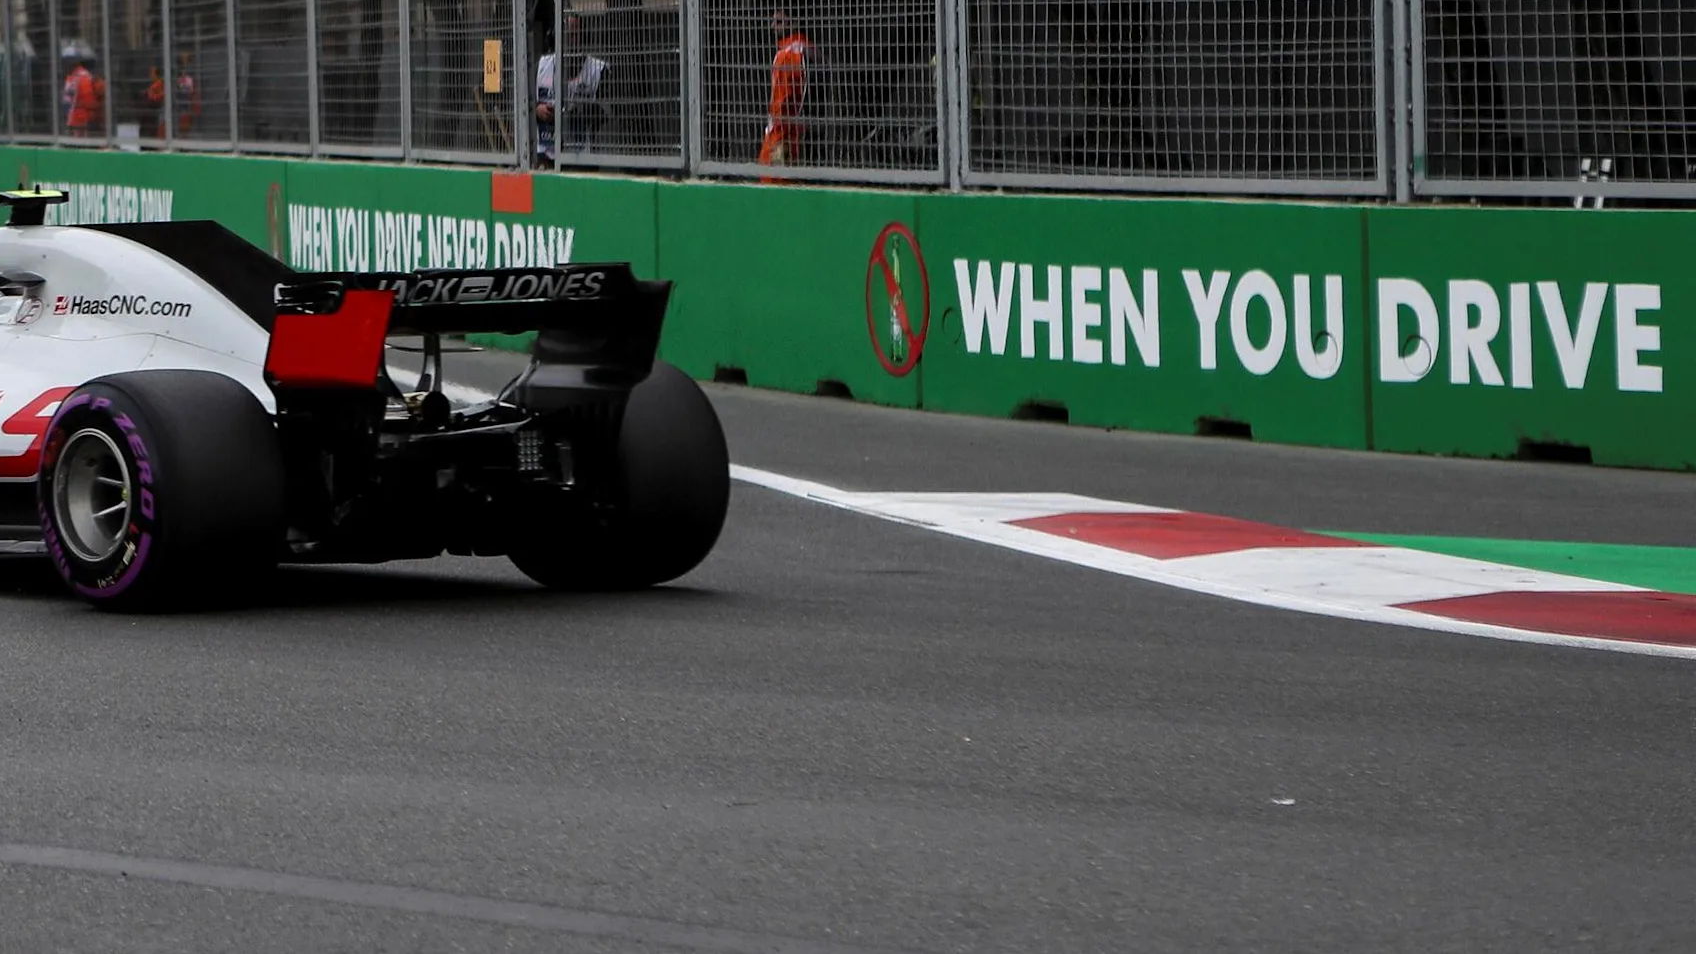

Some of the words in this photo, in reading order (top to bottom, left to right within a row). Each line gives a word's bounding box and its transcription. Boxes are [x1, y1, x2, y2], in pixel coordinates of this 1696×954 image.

[288, 203, 333, 272] WHEN
[335, 206, 370, 273] YOU
[374, 210, 422, 273] DRIVE
[428, 214, 489, 270] NEVER
[494, 221, 576, 270] DRINK
[70, 294, 192, 318] HaasCNC.com
[491, 271, 605, 301] JONES
[954, 257, 1162, 368] WHEN
[1181, 268, 1345, 380] YOU
[1378, 277, 1663, 394] DRIVE
[112, 411, 155, 521] ZERO
